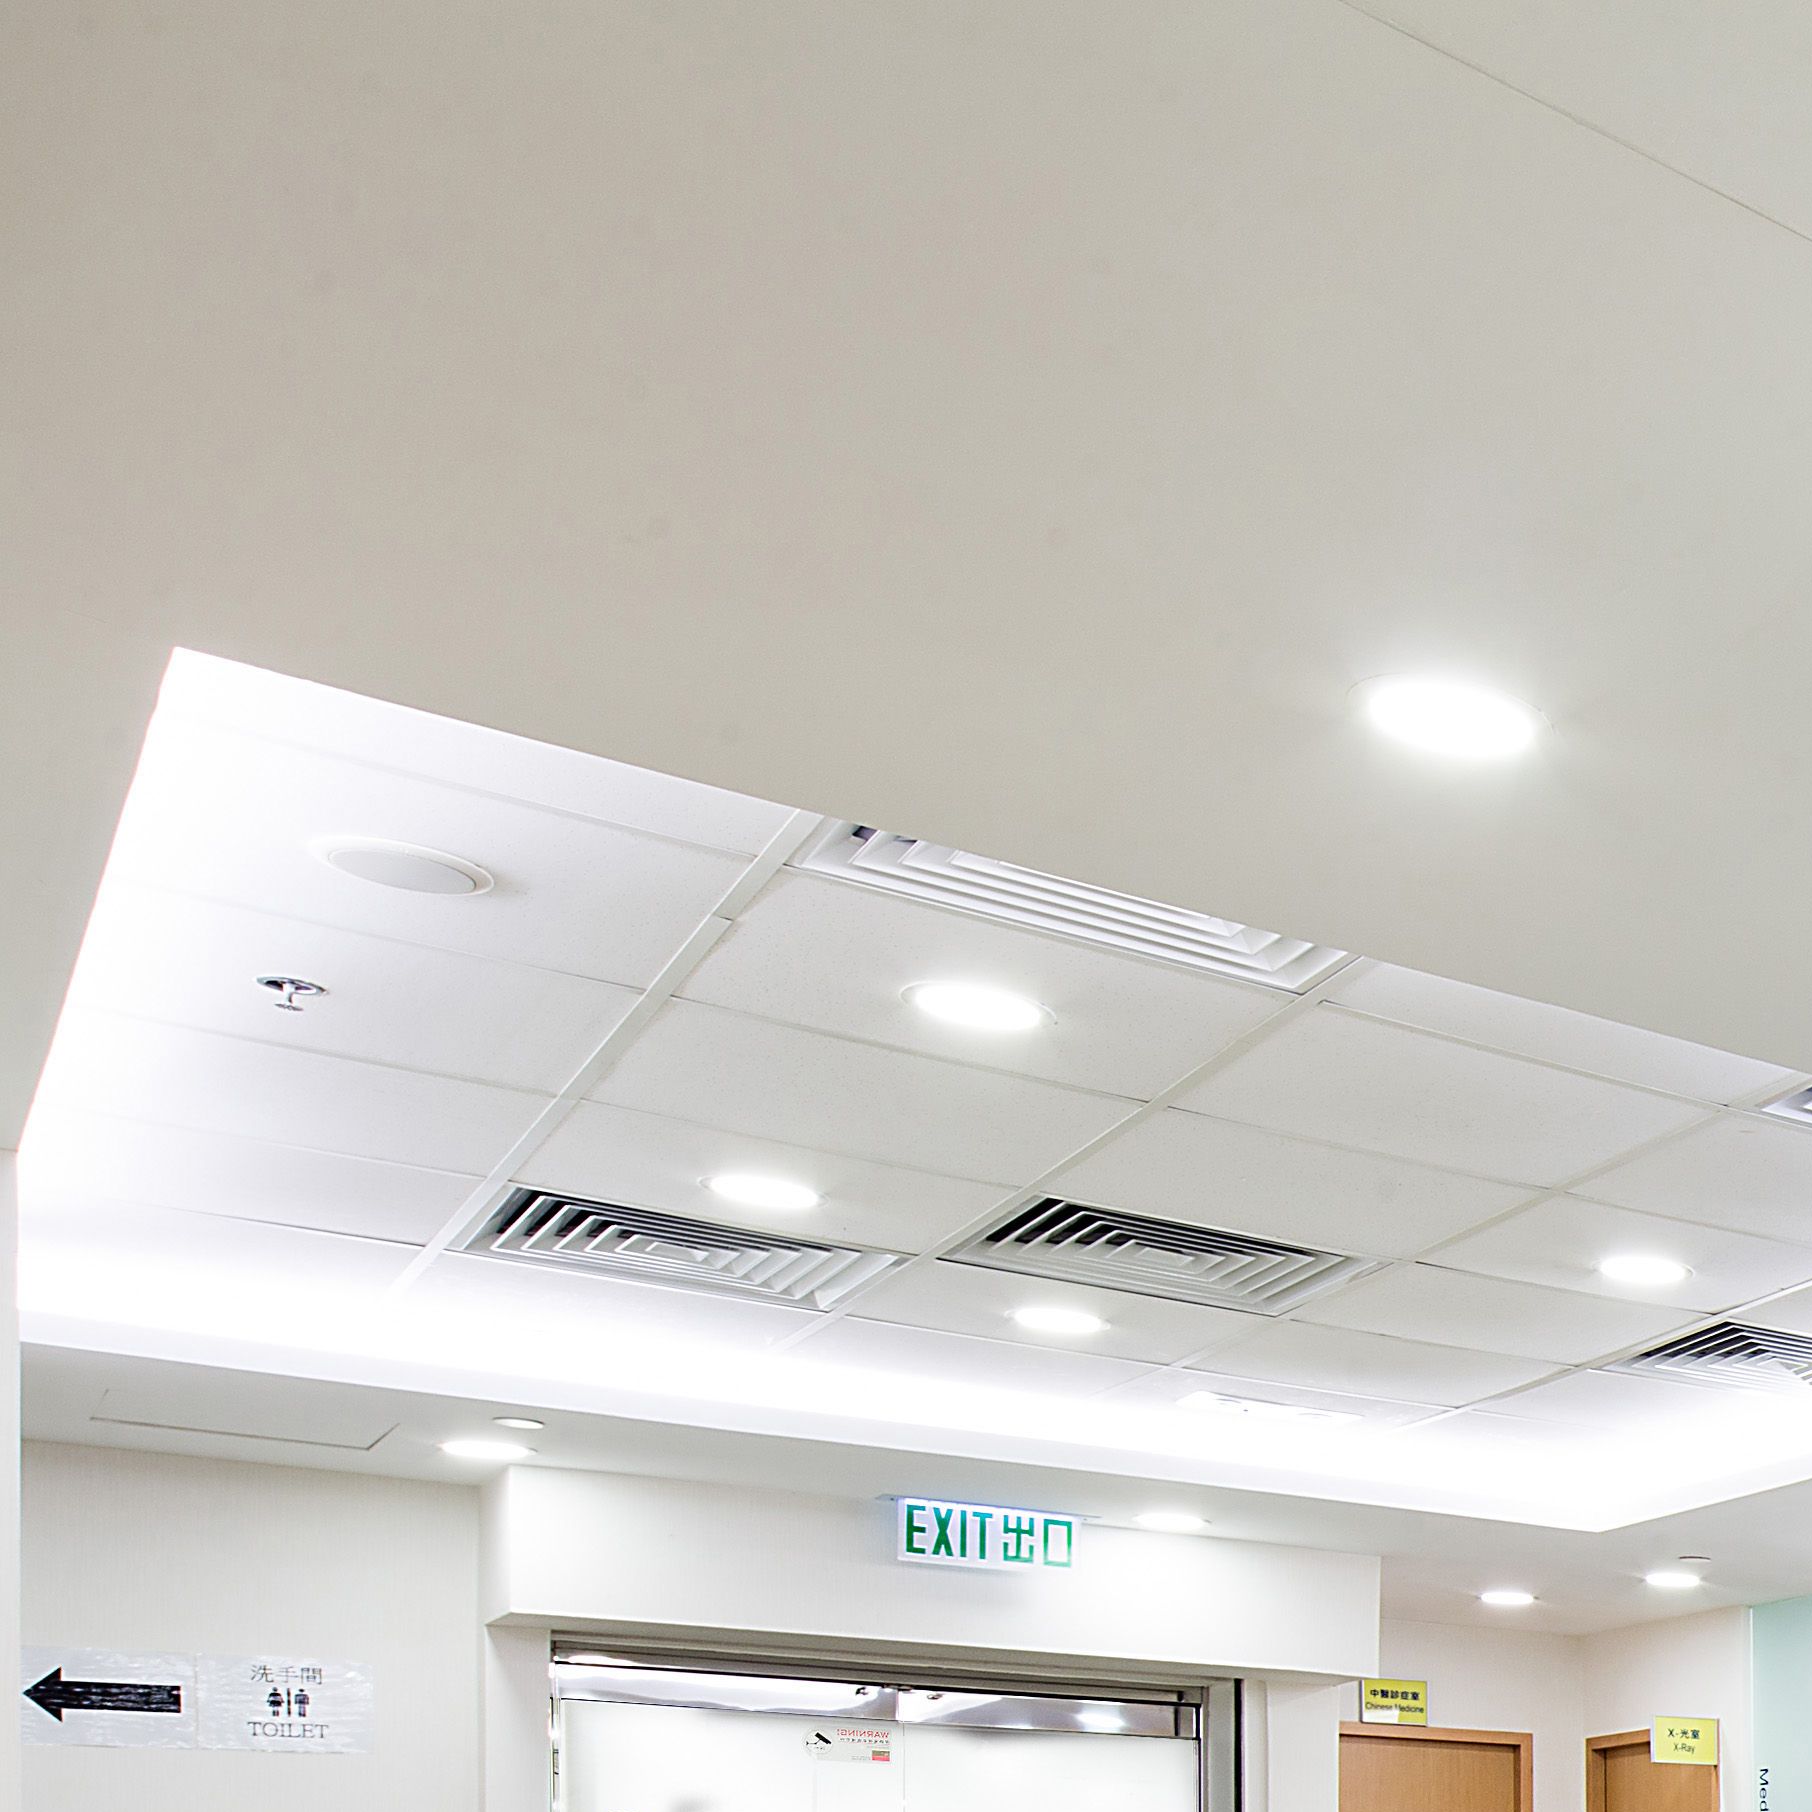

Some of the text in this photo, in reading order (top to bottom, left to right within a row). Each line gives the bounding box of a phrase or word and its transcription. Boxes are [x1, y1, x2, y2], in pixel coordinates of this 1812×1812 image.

[906, 1504, 1072, 1567] EXIT 出口
[250, 1665, 322, 1685] 洗手間
[247, 1721, 329, 1738] TOILET
[1673, 1743, 1695, 1755] X-Ray
